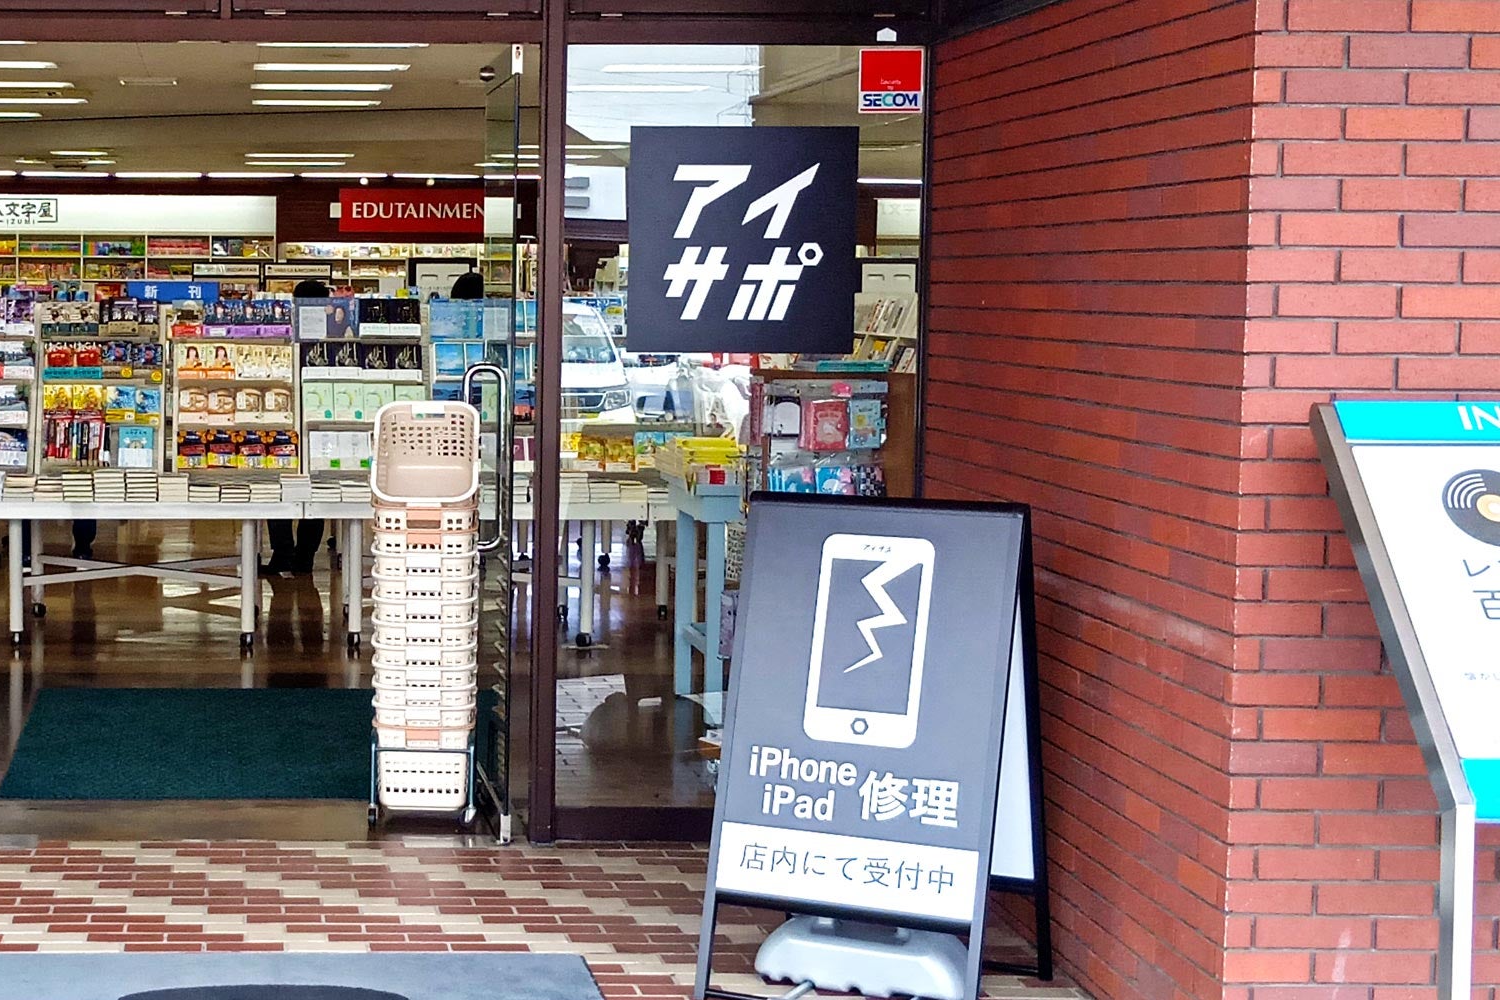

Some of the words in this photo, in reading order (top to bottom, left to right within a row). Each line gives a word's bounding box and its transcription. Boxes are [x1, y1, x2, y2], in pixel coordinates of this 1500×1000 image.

[863, 93, 918, 107] SECOM
[749, 745, 858, 787] iPhone
[762, 783, 836, 822] iPad
[858, 770, 960, 829] 修理
[739, 842, 954, 894] 店内にて受付中
